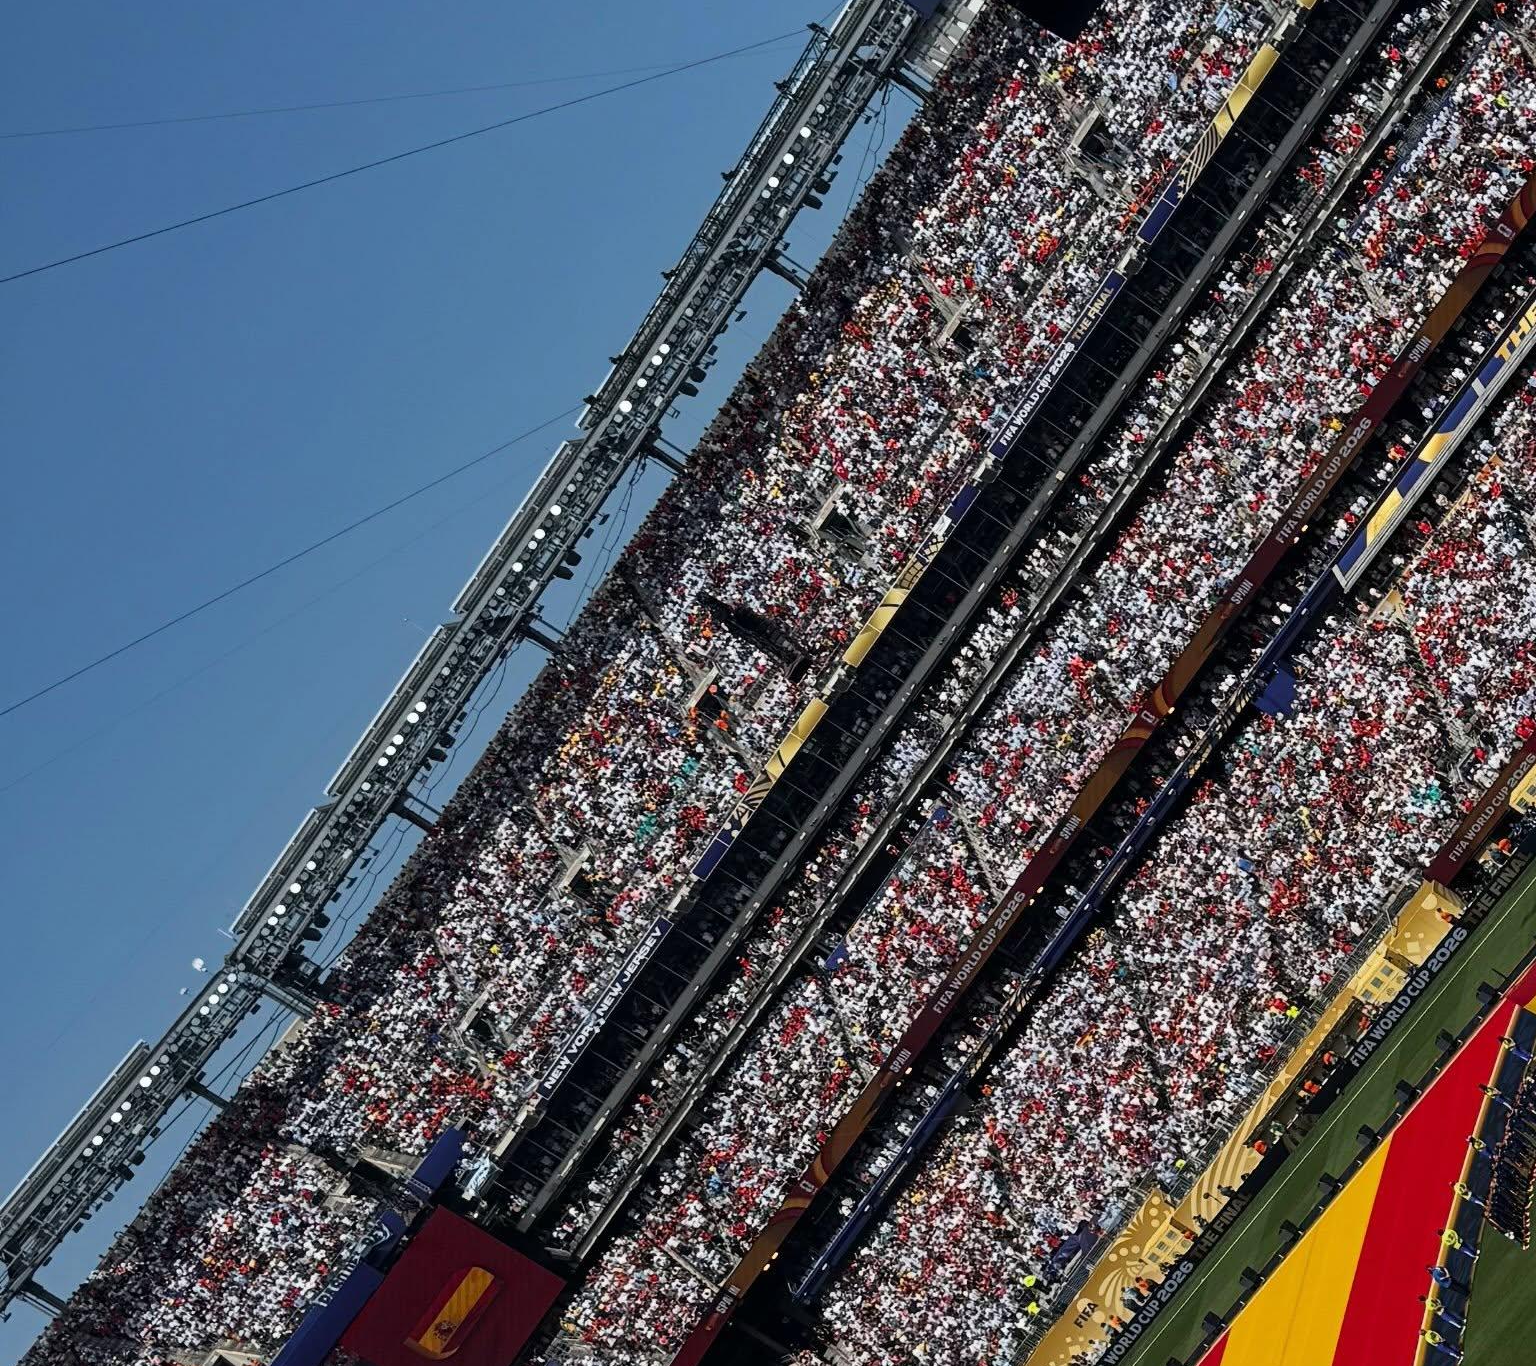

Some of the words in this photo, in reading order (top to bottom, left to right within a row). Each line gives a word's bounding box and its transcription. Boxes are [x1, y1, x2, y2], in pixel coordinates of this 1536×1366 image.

[998, 423, 1019, 447] FIFA
[1013, 392, 1040, 426] WORLD
[1034, 373, 1054, 395] CUP
[1047, 341, 1076, 377] 2026
[1071, 317, 1092, 343] THE
[1086, 285, 1115, 321] FINAL
[1408, 335, 1433, 363] SPAIN
[1274, 517, 1299, 545] FIFA
[1291, 477, 1328, 522] WORLD
[1320, 455, 1344, 482] CUP
[1337, 415, 1373, 459] 2026
[1230, 578, 1255, 607] SPAIN
[1059, 814, 1082, 841] SPAIN
[1447, 837, 1469, 862] FIFA
[1462, 804, 1496, 843] WORLD
[1489, 785, 1511, 809] CUP
[931, 987, 956, 1015] FIFA
[948, 949, 983, 992] WORLD
[975, 926, 999, 954] CUP
[991, 888, 1026, 931] 2026
[1348, 1037, 1378, 1069] FIFA
[1370, 996, 1411, 1043] WORLD
[1405, 969, 1433, 999] CUP
[1426, 925, 1469, 974] 2026
[1464, 892, 1495, 927] THE
[1487, 846, 1533, 898] FINAL
[542, 1056, 572, 1092] NEW
[566, 1015, 600, 1058] YOR
[594, 981, 624, 1018] NEW
[618, 925, 663, 984] JERSEY
[889, 1047, 912, 1075] SPAIN
[1072, 1298, 1100, 1331] FIFA
[1103, 1321, 1143, 1366] WORLD
[1136, 1298, 1163, 1326] CUP
[1154, 1258, 1195, 1304] 2026
[1190, 1228, 1220, 1261] THE
[1212, 1188, 1252, 1234] FINAL
